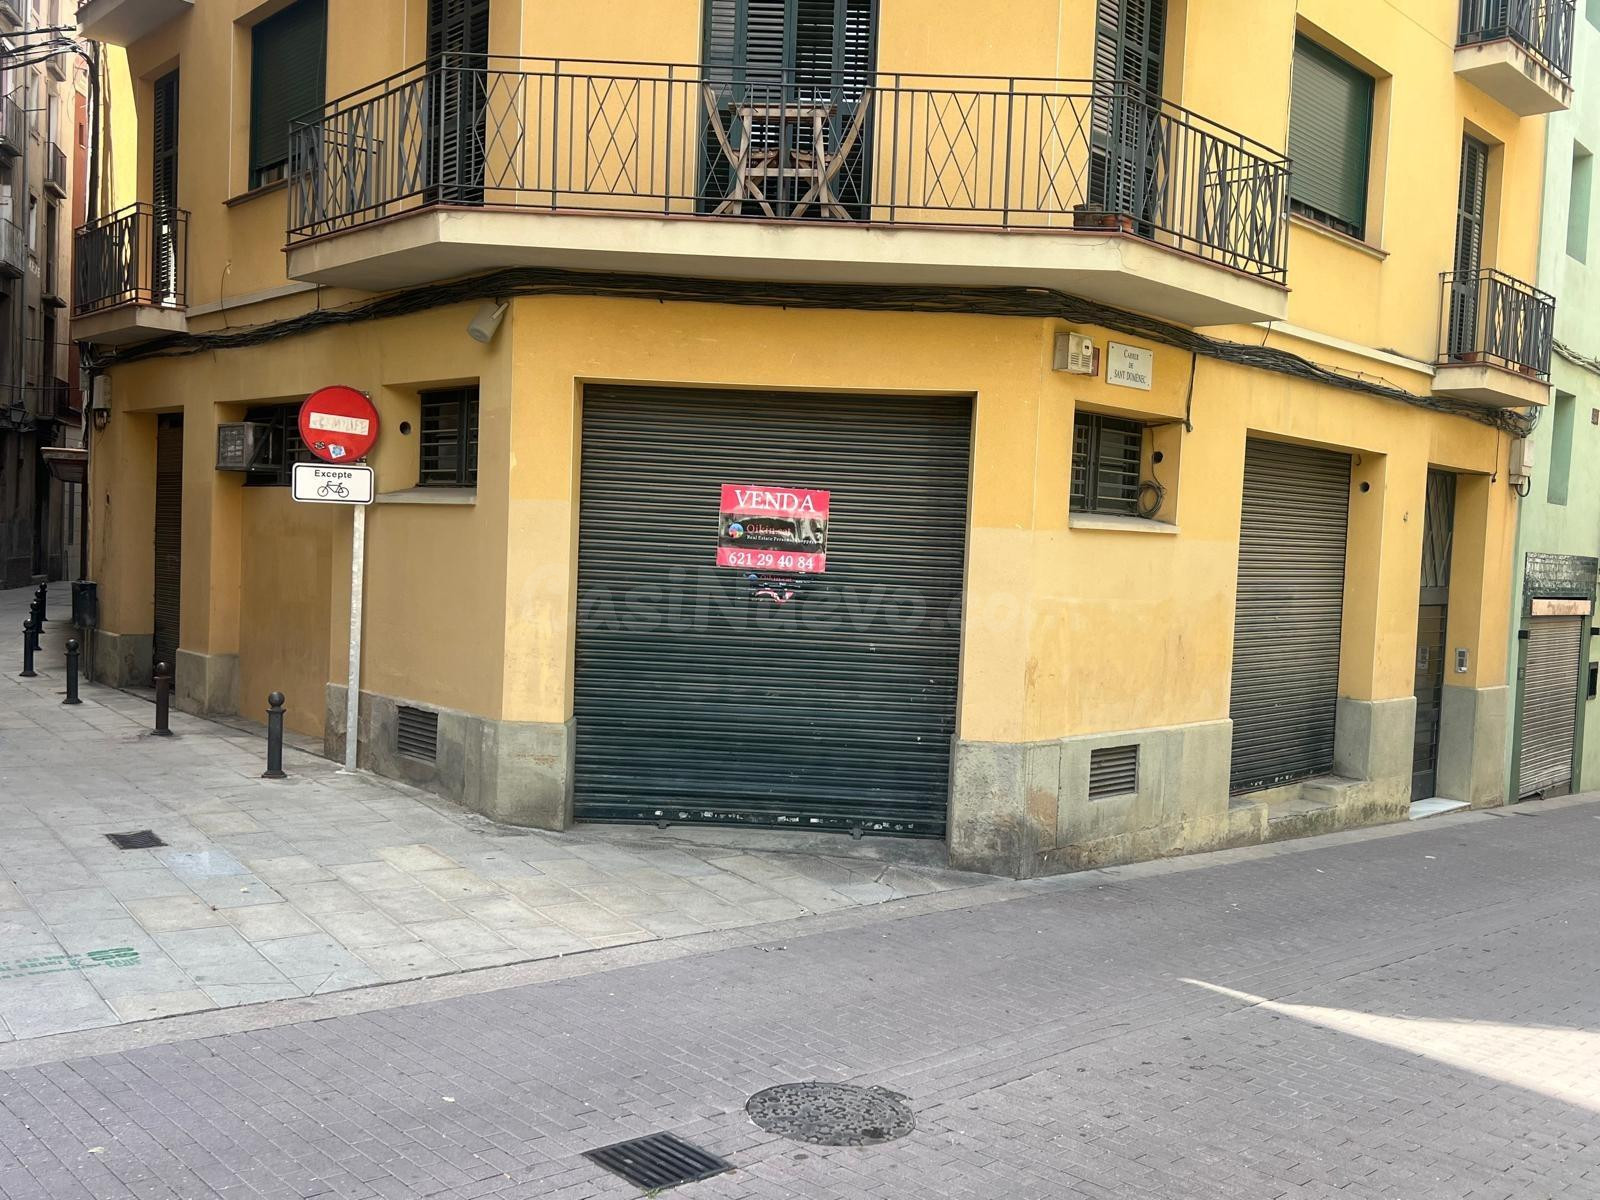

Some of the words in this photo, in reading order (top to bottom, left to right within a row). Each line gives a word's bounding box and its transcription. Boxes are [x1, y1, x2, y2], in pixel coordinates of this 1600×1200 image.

[1114, 369, 1126, 380] SANT
[314, 469, 353, 479] Excepte
[734, 489, 816, 513] VENDA
[728, 552, 752, 565] 621
[756, 554, 774, 566] 29
[777, 555, 794, 568] 40
[797, 556, 814, 570] 84
